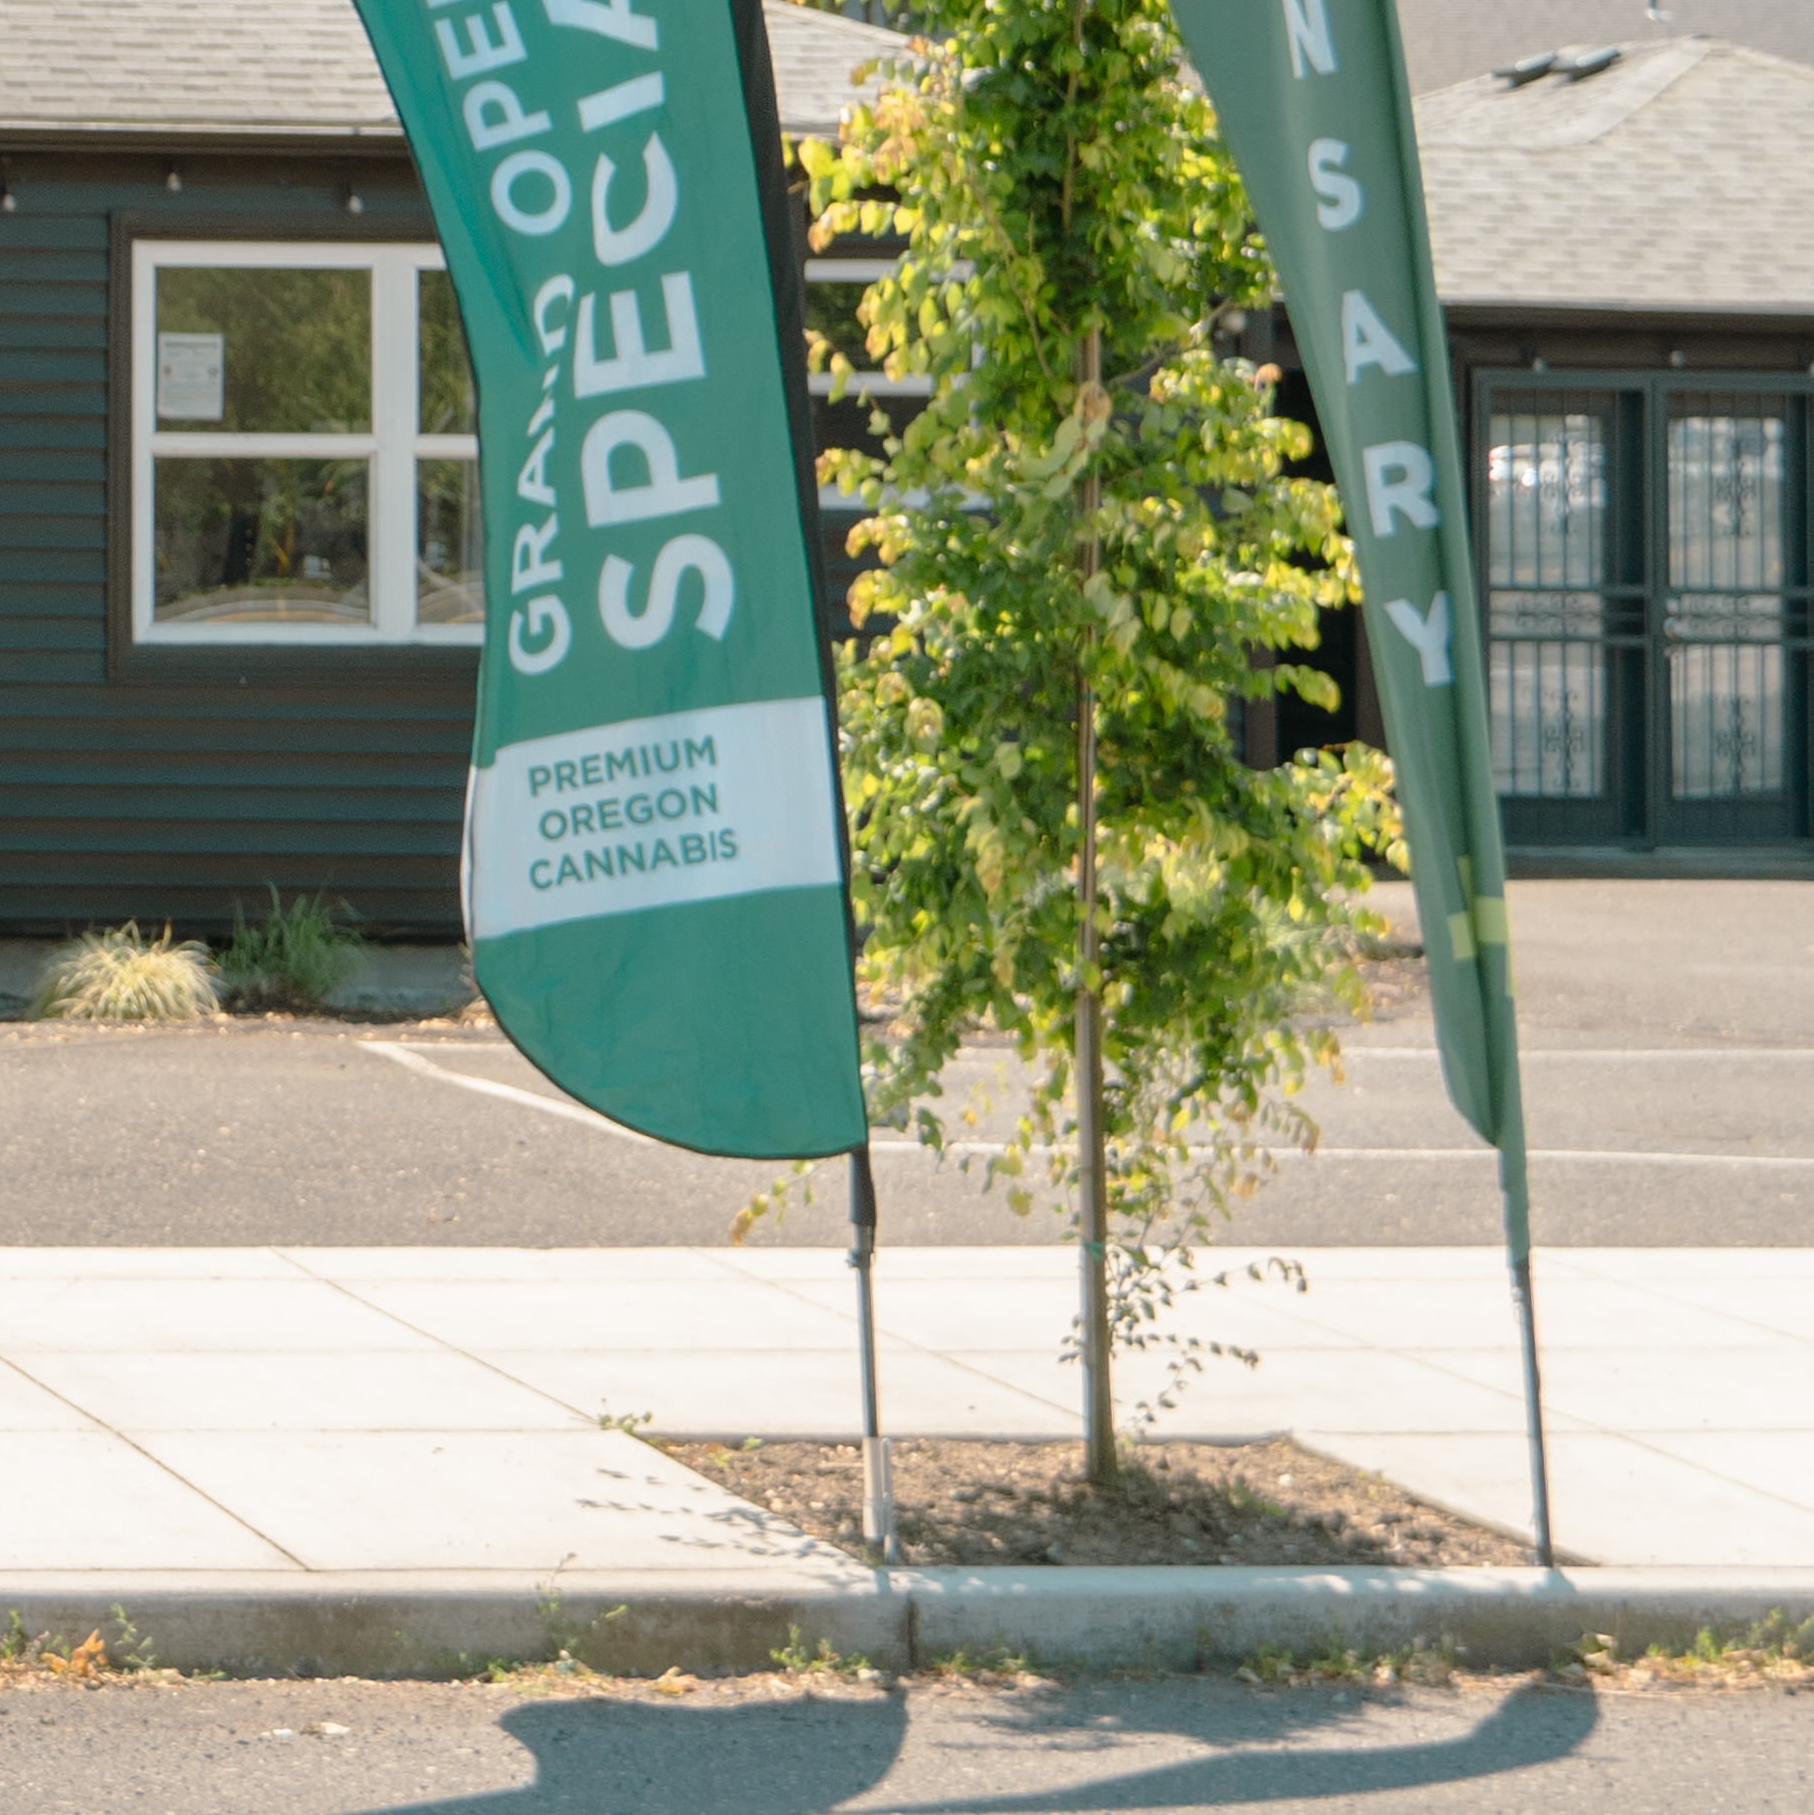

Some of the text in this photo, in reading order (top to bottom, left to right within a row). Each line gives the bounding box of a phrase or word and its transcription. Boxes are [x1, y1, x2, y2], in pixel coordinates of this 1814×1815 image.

[528, 735, 715, 797] PREMIUM
[538, 783, 716, 840] OREGON
[528, 828, 737, 890] CANNABIS
